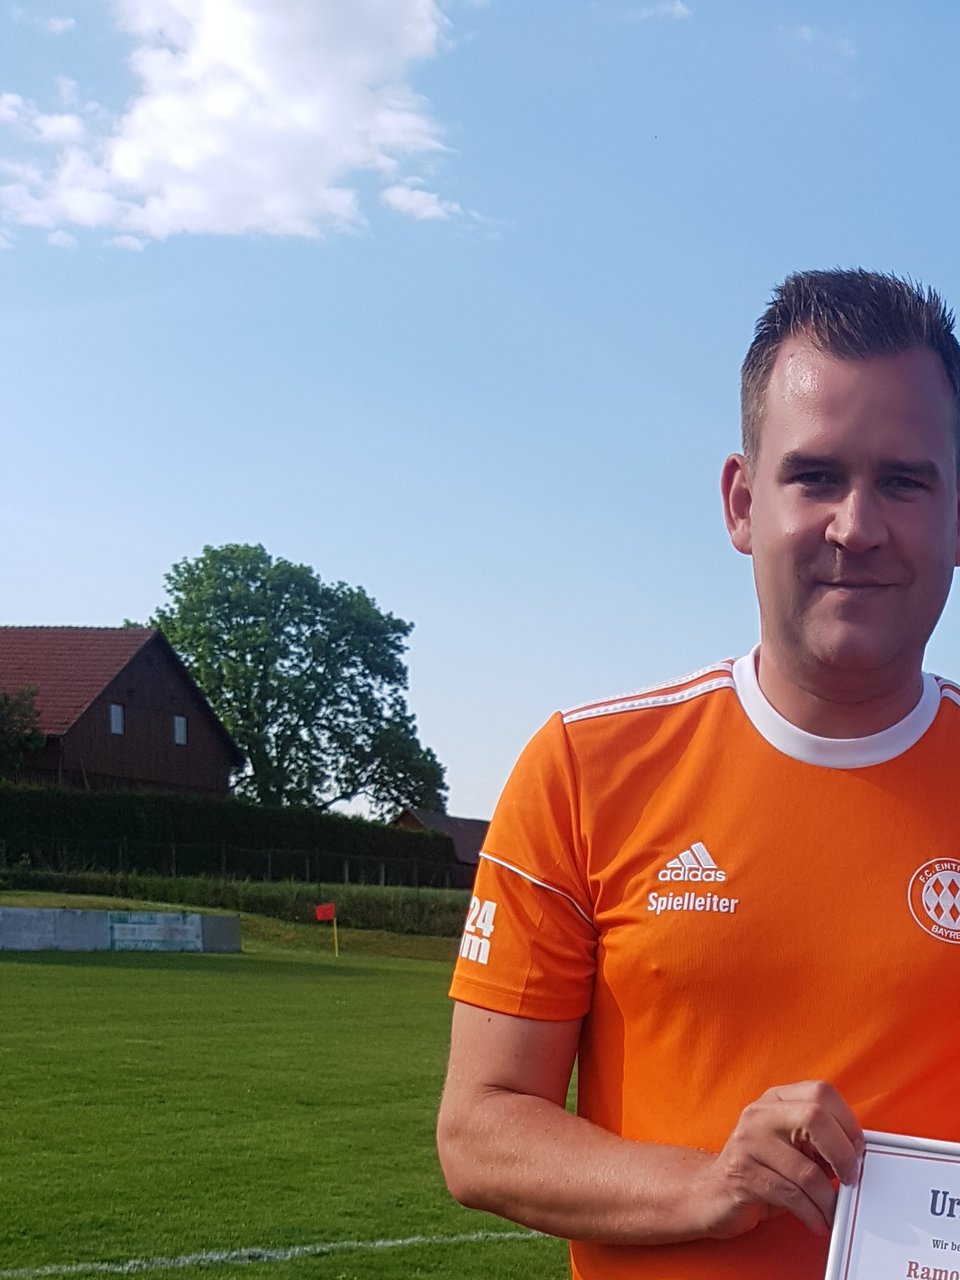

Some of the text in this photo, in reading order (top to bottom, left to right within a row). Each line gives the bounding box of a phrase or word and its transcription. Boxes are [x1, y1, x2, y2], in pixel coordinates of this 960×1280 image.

[658, 866, 727, 882] adidas
[647, 892, 739, 915] Spielleiter
[932, 1239, 949, 1250] Wir
